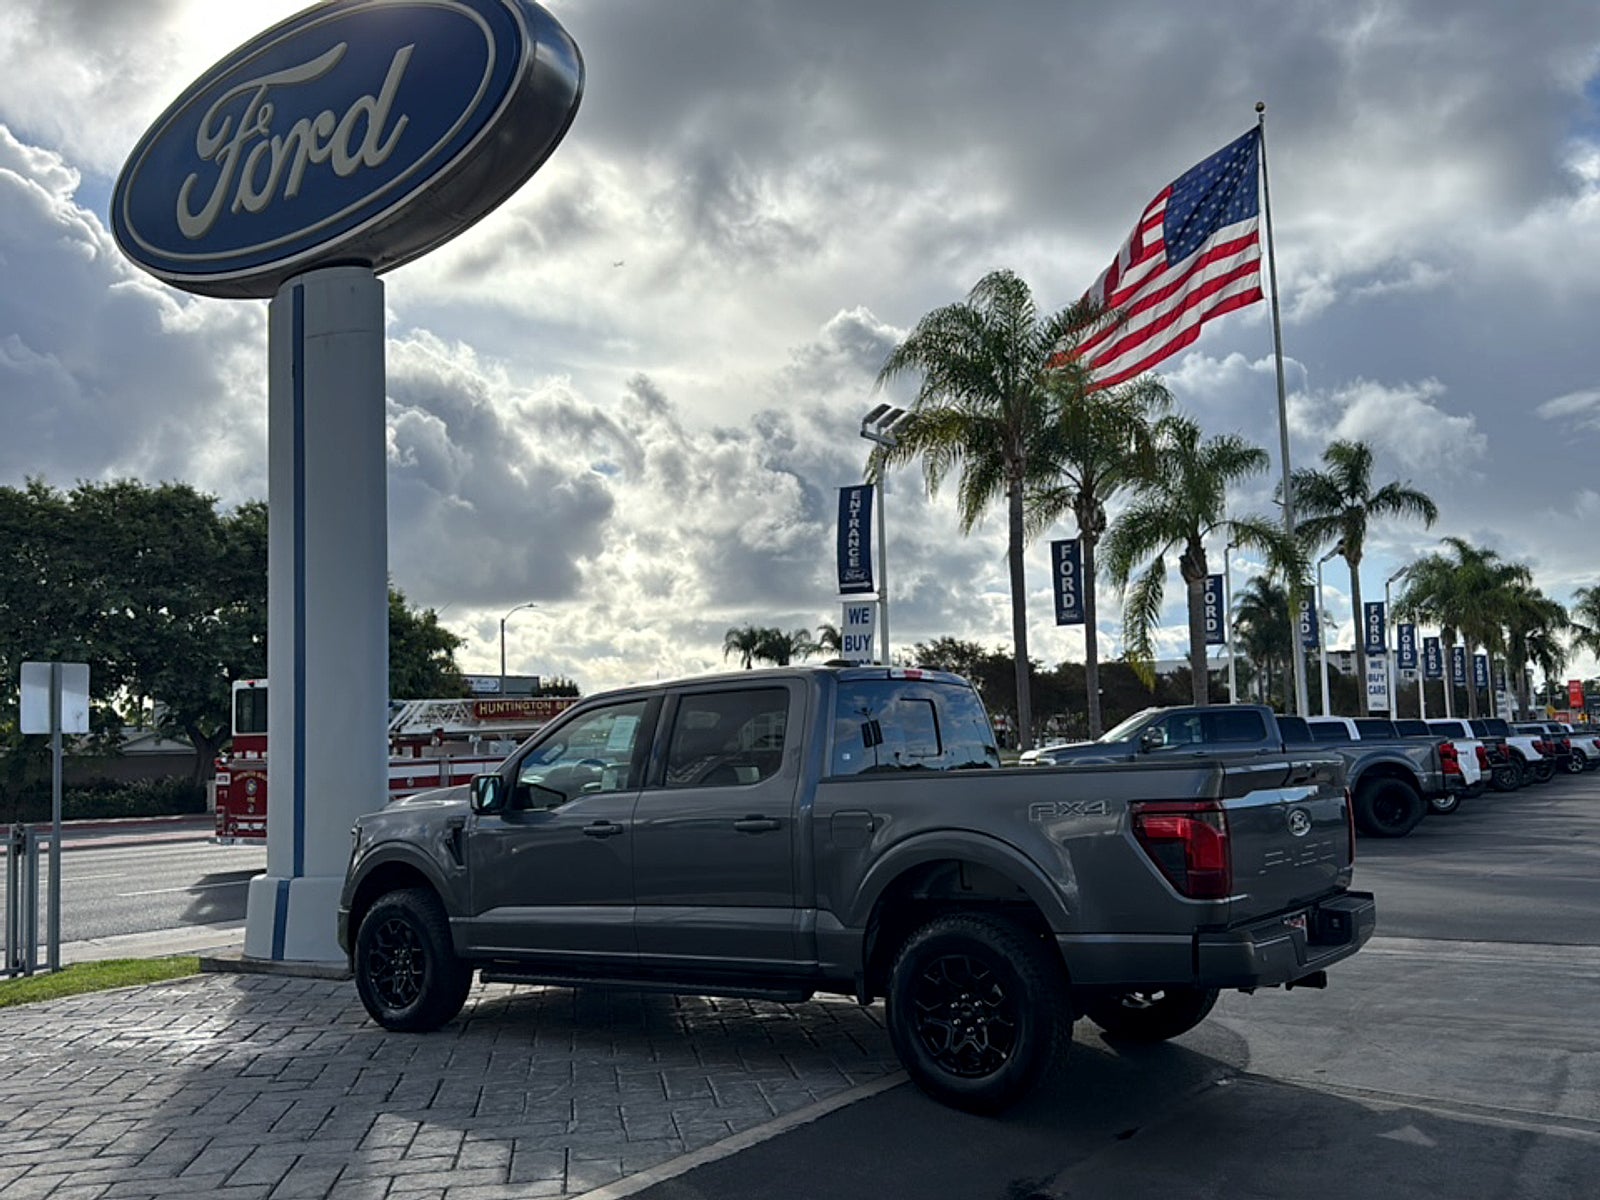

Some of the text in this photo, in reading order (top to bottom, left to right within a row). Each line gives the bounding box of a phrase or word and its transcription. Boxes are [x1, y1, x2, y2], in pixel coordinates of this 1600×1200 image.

[176, 41, 415, 239] Ford
[848, 490, 861, 568] ENTRANCE
[1060, 544, 1075, 608] FORD
[848, 607, 870, 624] WE
[1204, 578, 1218, 631] FORD
[1299, 588, 1310, 633] ORD
[1369, 605, 1380, 644] FORD
[844, 634, 872, 652] BUY
[1402, 626, 1412, 660] FORD
[1428, 639, 1437, 669] FORD
[1370, 661, 1383, 669] WE
[1454, 648, 1462, 676] FORD
[1368, 673, 1385, 683] BUY
[1368, 685, 1386, 695] CARS
[480, 701, 551, 716] HUNTINGTON
[1028, 799, 1111, 822] FX4
